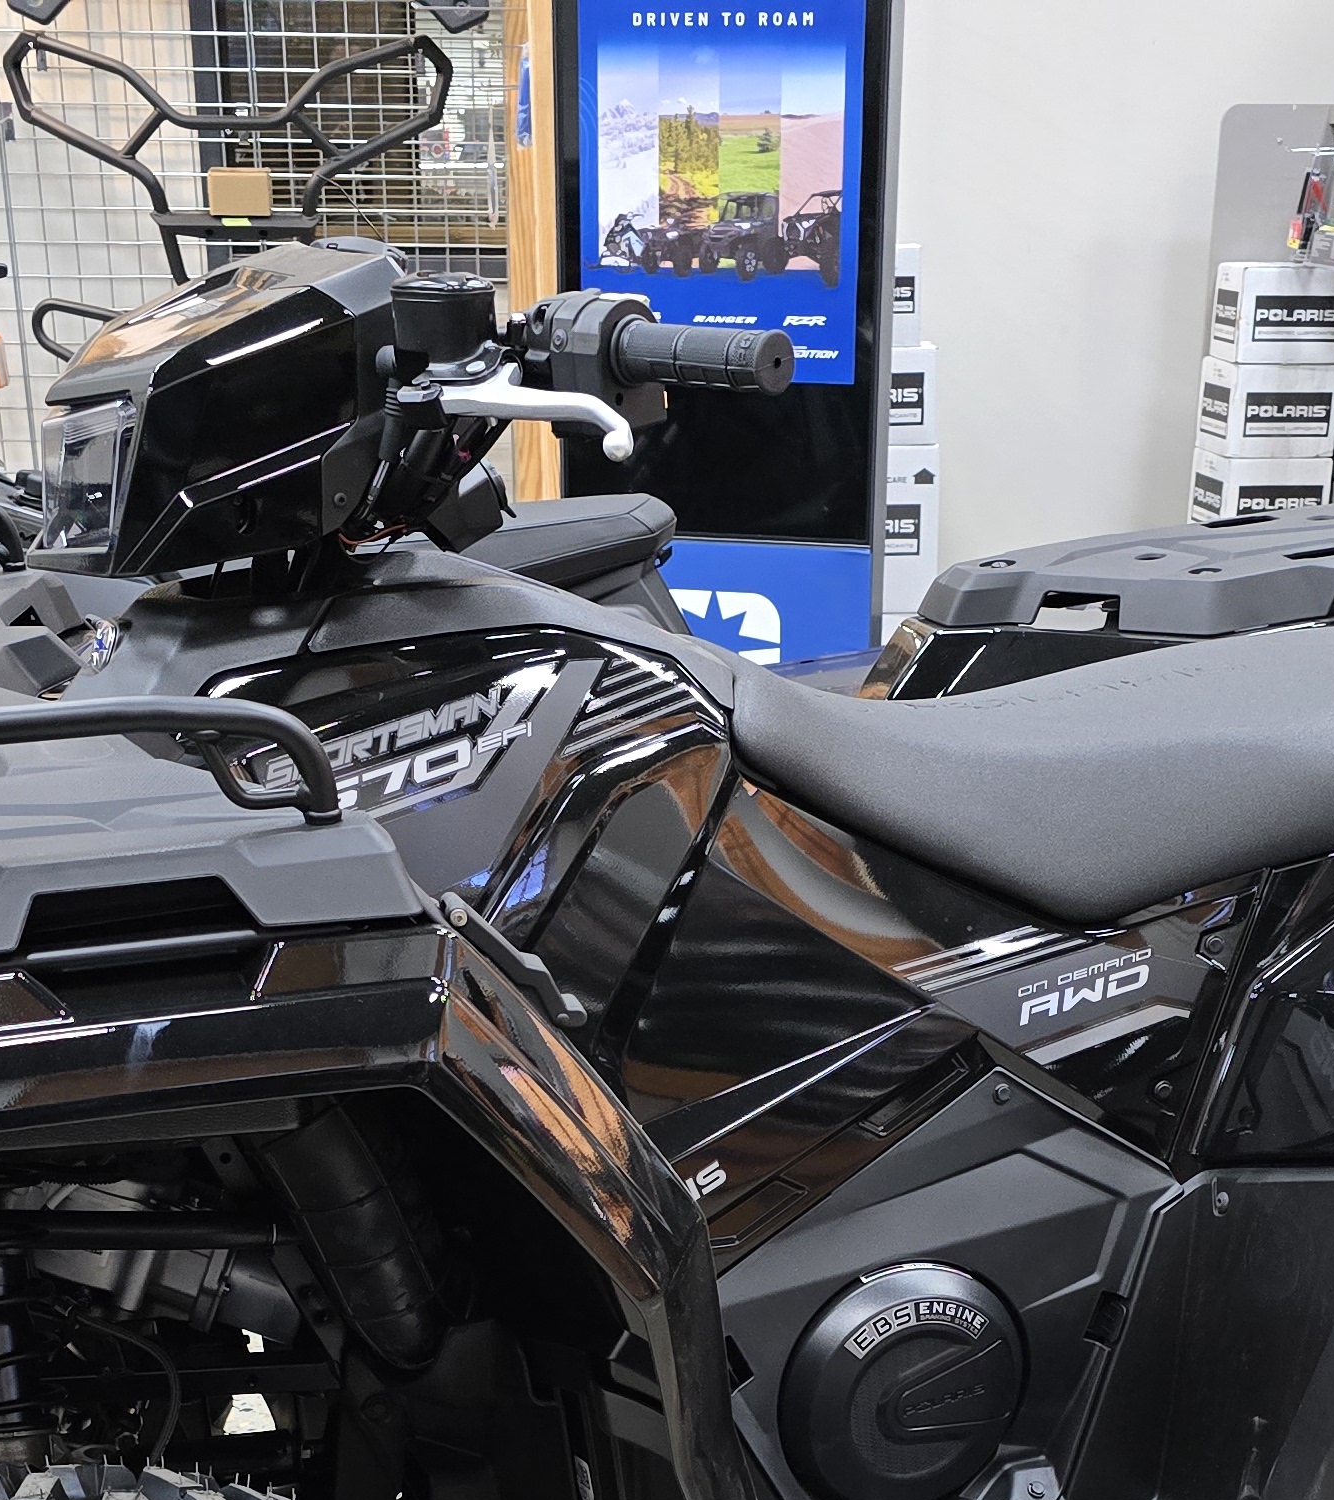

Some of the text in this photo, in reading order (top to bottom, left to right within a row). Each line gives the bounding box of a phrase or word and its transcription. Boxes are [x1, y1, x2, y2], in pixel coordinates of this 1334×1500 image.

[632, 12, 816, 27] DRIVEN TO ROAM
[693, 315, 827, 327] RANGER RZR
[1247, 405, 1328, 418] POLARIS
[477, 722, 532, 754] EFI
[1018, 948, 1152, 997] ON DEMAND
[1019, 964, 1150, 1027] AWD
[854, 1302, 985, 1353] EBS ENGINE
